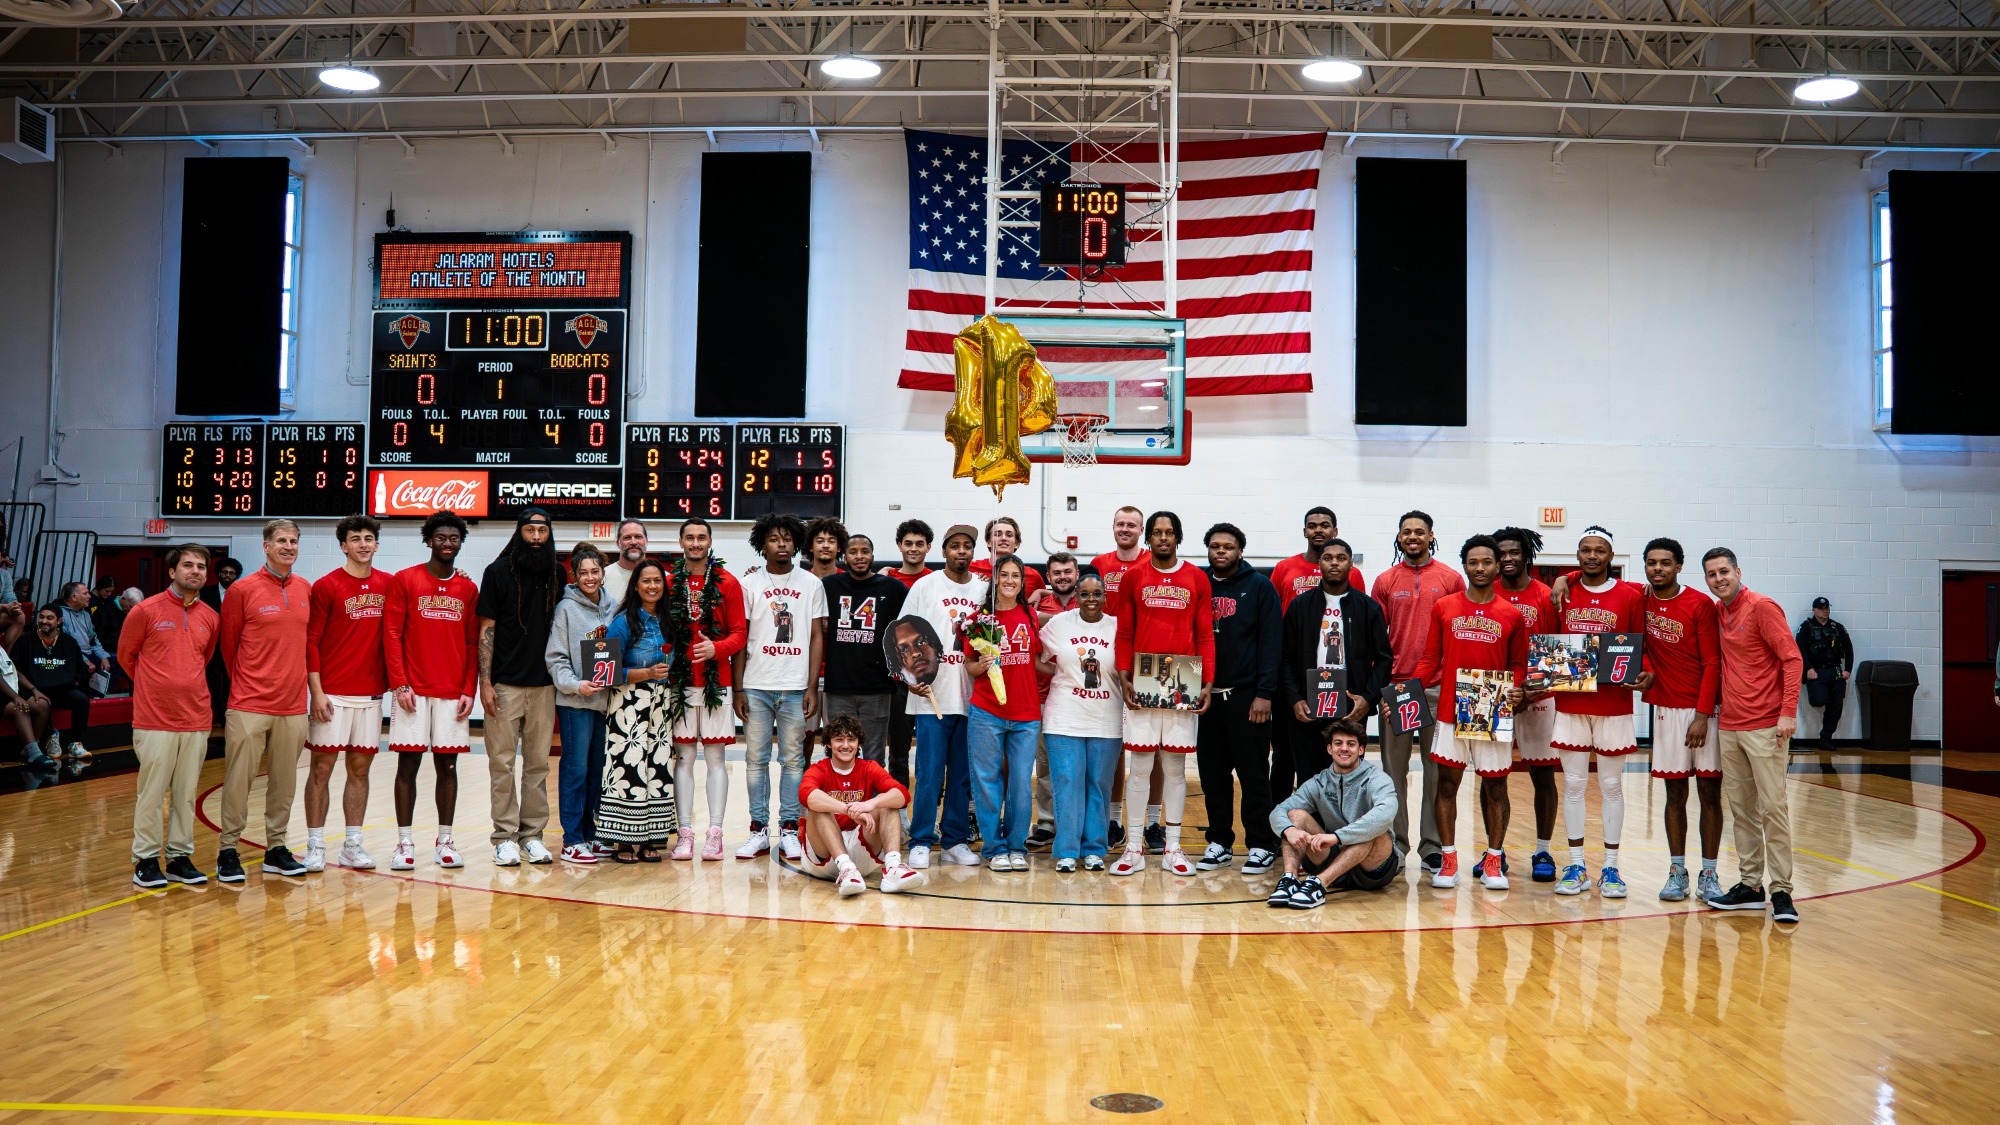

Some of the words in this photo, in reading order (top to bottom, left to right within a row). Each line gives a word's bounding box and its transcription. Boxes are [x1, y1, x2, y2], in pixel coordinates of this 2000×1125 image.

[1057, 191, 1118, 214] 11:00
[1084, 217, 1107, 257] 0
[434, 252, 494, 269] JALARAM
[502, 252, 555, 268] HOTELS
[410, 271, 472, 287] ATHLETE
[480, 271, 497, 287] OF
[505, 270, 532, 287] THE
[540, 270, 586, 287] MONTH
[389, 319, 430, 333] FLAGLER
[465, 315, 543, 346] 11:00
[565, 318, 607, 333] FLAGLER
[389, 354, 437, 368] SAINTS
[478, 362, 513, 373] PERIOD
[550, 354, 610, 368] BOBCATS
[417, 374, 435, 405] 0
[498, 379, 503, 400] 1
[588, 373, 606, 405] 0
[382, 409, 413, 420] FOULS
[424, 409, 450, 420] T.O.L.
[462, 409, 498, 420] PLAYER
[503, 409, 528, 420] FOUL
[538, 409, 566, 420] T.O.L.
[578, 409, 610, 420] FOULS
[170, 427, 196, 442] PLYR
[204, 427, 223, 442] FLS
[232, 427, 252, 441] PTS
[272, 426, 300, 442] PLYR
[306, 426, 326, 442] FLS
[335, 426, 355, 442] PTS
[393, 422, 408, 446] 0
[430, 424, 444, 444] 4
[545, 424, 559, 445] 4
[589, 422, 604, 447] 0
[632, 427, 661, 442] PLYR
[668, 427, 689, 442] FLS
[700, 427, 721, 442] PTS
[742, 428, 771, 443] PLYR
[779, 428, 800, 443] FLS
[810, 428, 832, 444] PTS
[184, 447, 194, 465] 2
[215, 448, 224, 465] 3
[236, 448, 253, 465] 13
[280, 448, 296, 465] 15
[323, 450, 327, 463] 1
[345, 448, 356, 465] 0
[380, 452, 412, 463] SCORE
[476, 452, 511, 463] MATCH
[576, 452, 608, 464] SCORE
[647, 448, 659, 467] 0
[679, 450, 691, 466] 4
[697, 449, 722, 468] 24
[751, 449, 770, 468] 12
[797, 451, 802, 466] 1
[821, 450, 834, 468] 5
[177, 470, 194, 488] 10
[213, 472, 224, 487] 4
[229, 470, 252, 488] 20
[273, 470, 296, 488] 25
[316, 470, 326, 488] 0
[345, 470, 356, 488] 2
[648, 472, 659, 491] 3
[686, 474, 690, 490] 1
[710, 473, 722, 492] 8
[744, 473, 769, 492] 21
[796, 475, 801, 490] 1
[814, 474, 833, 492] 10
[391, 479, 482, 511] Coca-Cola
[498, 482, 613, 498] POWERADE
[176, 494, 193, 510] 14
[214, 494, 223, 512] 3
[235, 494, 251, 512] 10
[640, 498, 658, 514] 11
[678, 498, 690, 514] 4
[709, 497, 721, 516] 6
[1544, 508, 1563, 523] EXIT
[148, 520, 166, 534] EXIT
[593, 523, 612, 538] EXIT
[763, 588, 802, 600] BOOM
[1141, 584, 1190, 604] FLAGLER
[418, 595, 464, 615] FLAGLER
[942, 596, 979, 610] BOOM
[1147, 600, 1184, 608] BASKETBALL
[423, 610, 459, 620] BASKETBALL
[837, 595, 877, 631] 14
[1566, 607, 1618, 630] FLAGLER
[1452, 616, 1502, 638] FLAGLER
[1571, 623, 1608, 632] BASKETBALL
[836, 628, 875, 644] REEVES
[1070, 636, 1110, 649] BOOM
[1457, 631, 1494, 641] BASKETBALL
[762, 646, 802, 656] SQUAD
[592, 660, 616, 686] 21
[1610, 656, 1630, 683] 5
[1072, 687, 1110, 700] SQUAD
[1316, 691, 1339, 718] 14
[1398, 700, 1422, 732] 12
